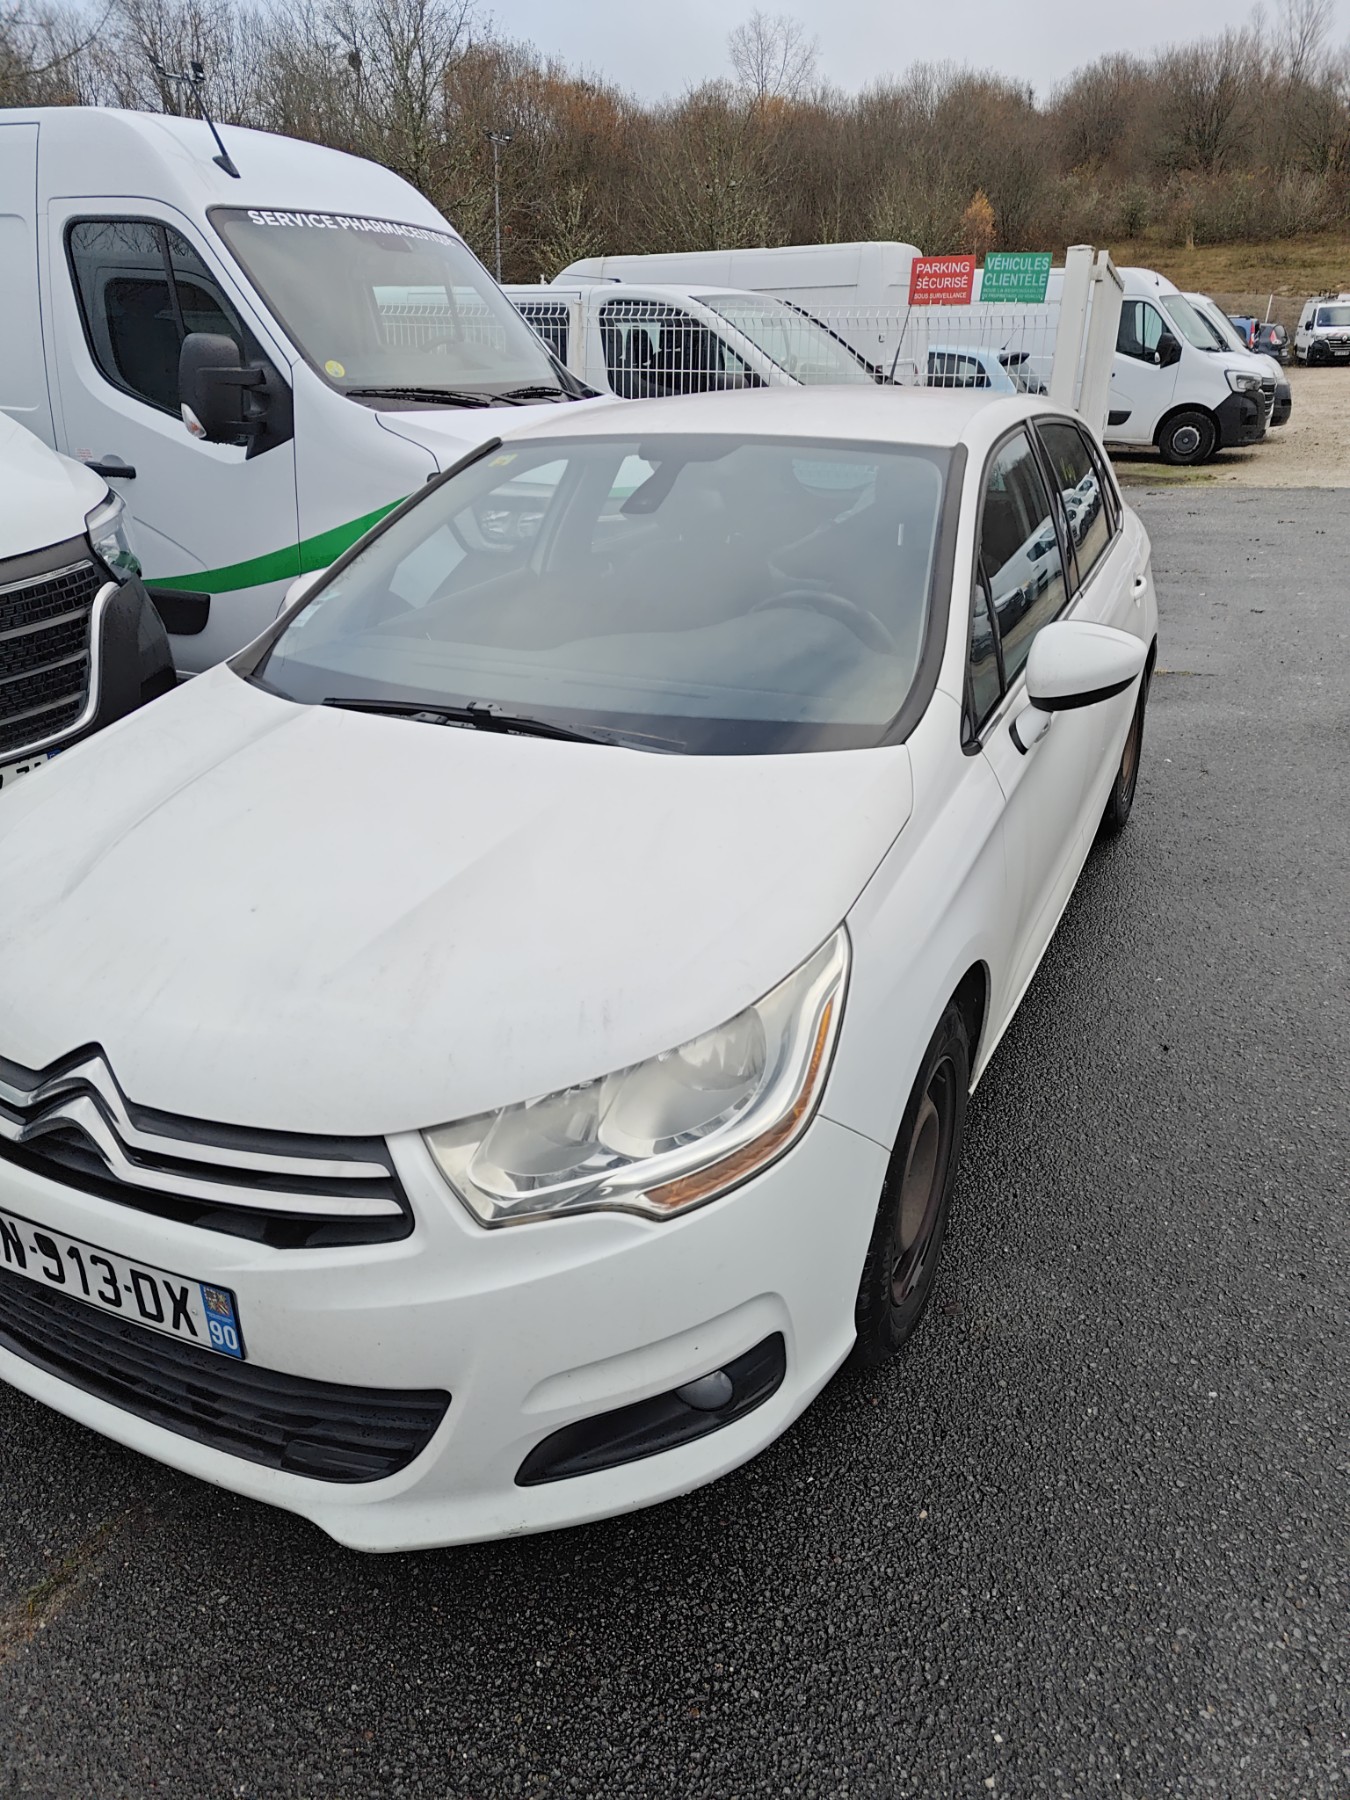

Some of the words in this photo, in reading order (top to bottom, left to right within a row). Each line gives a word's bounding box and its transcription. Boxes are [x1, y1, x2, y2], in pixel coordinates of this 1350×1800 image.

[247, 210, 339, 230] SERVICE
[916, 261, 970, 274] PARKING
[987, 254, 1050, 271] VÉHICULES
[916, 275, 969, 289] SÉCURISÉ
[984, 271, 1047, 286] CLIENTÈLE
[929, 291, 967, 299] SURVEILLANCE
[209, 1320, 238, 1350] 90
